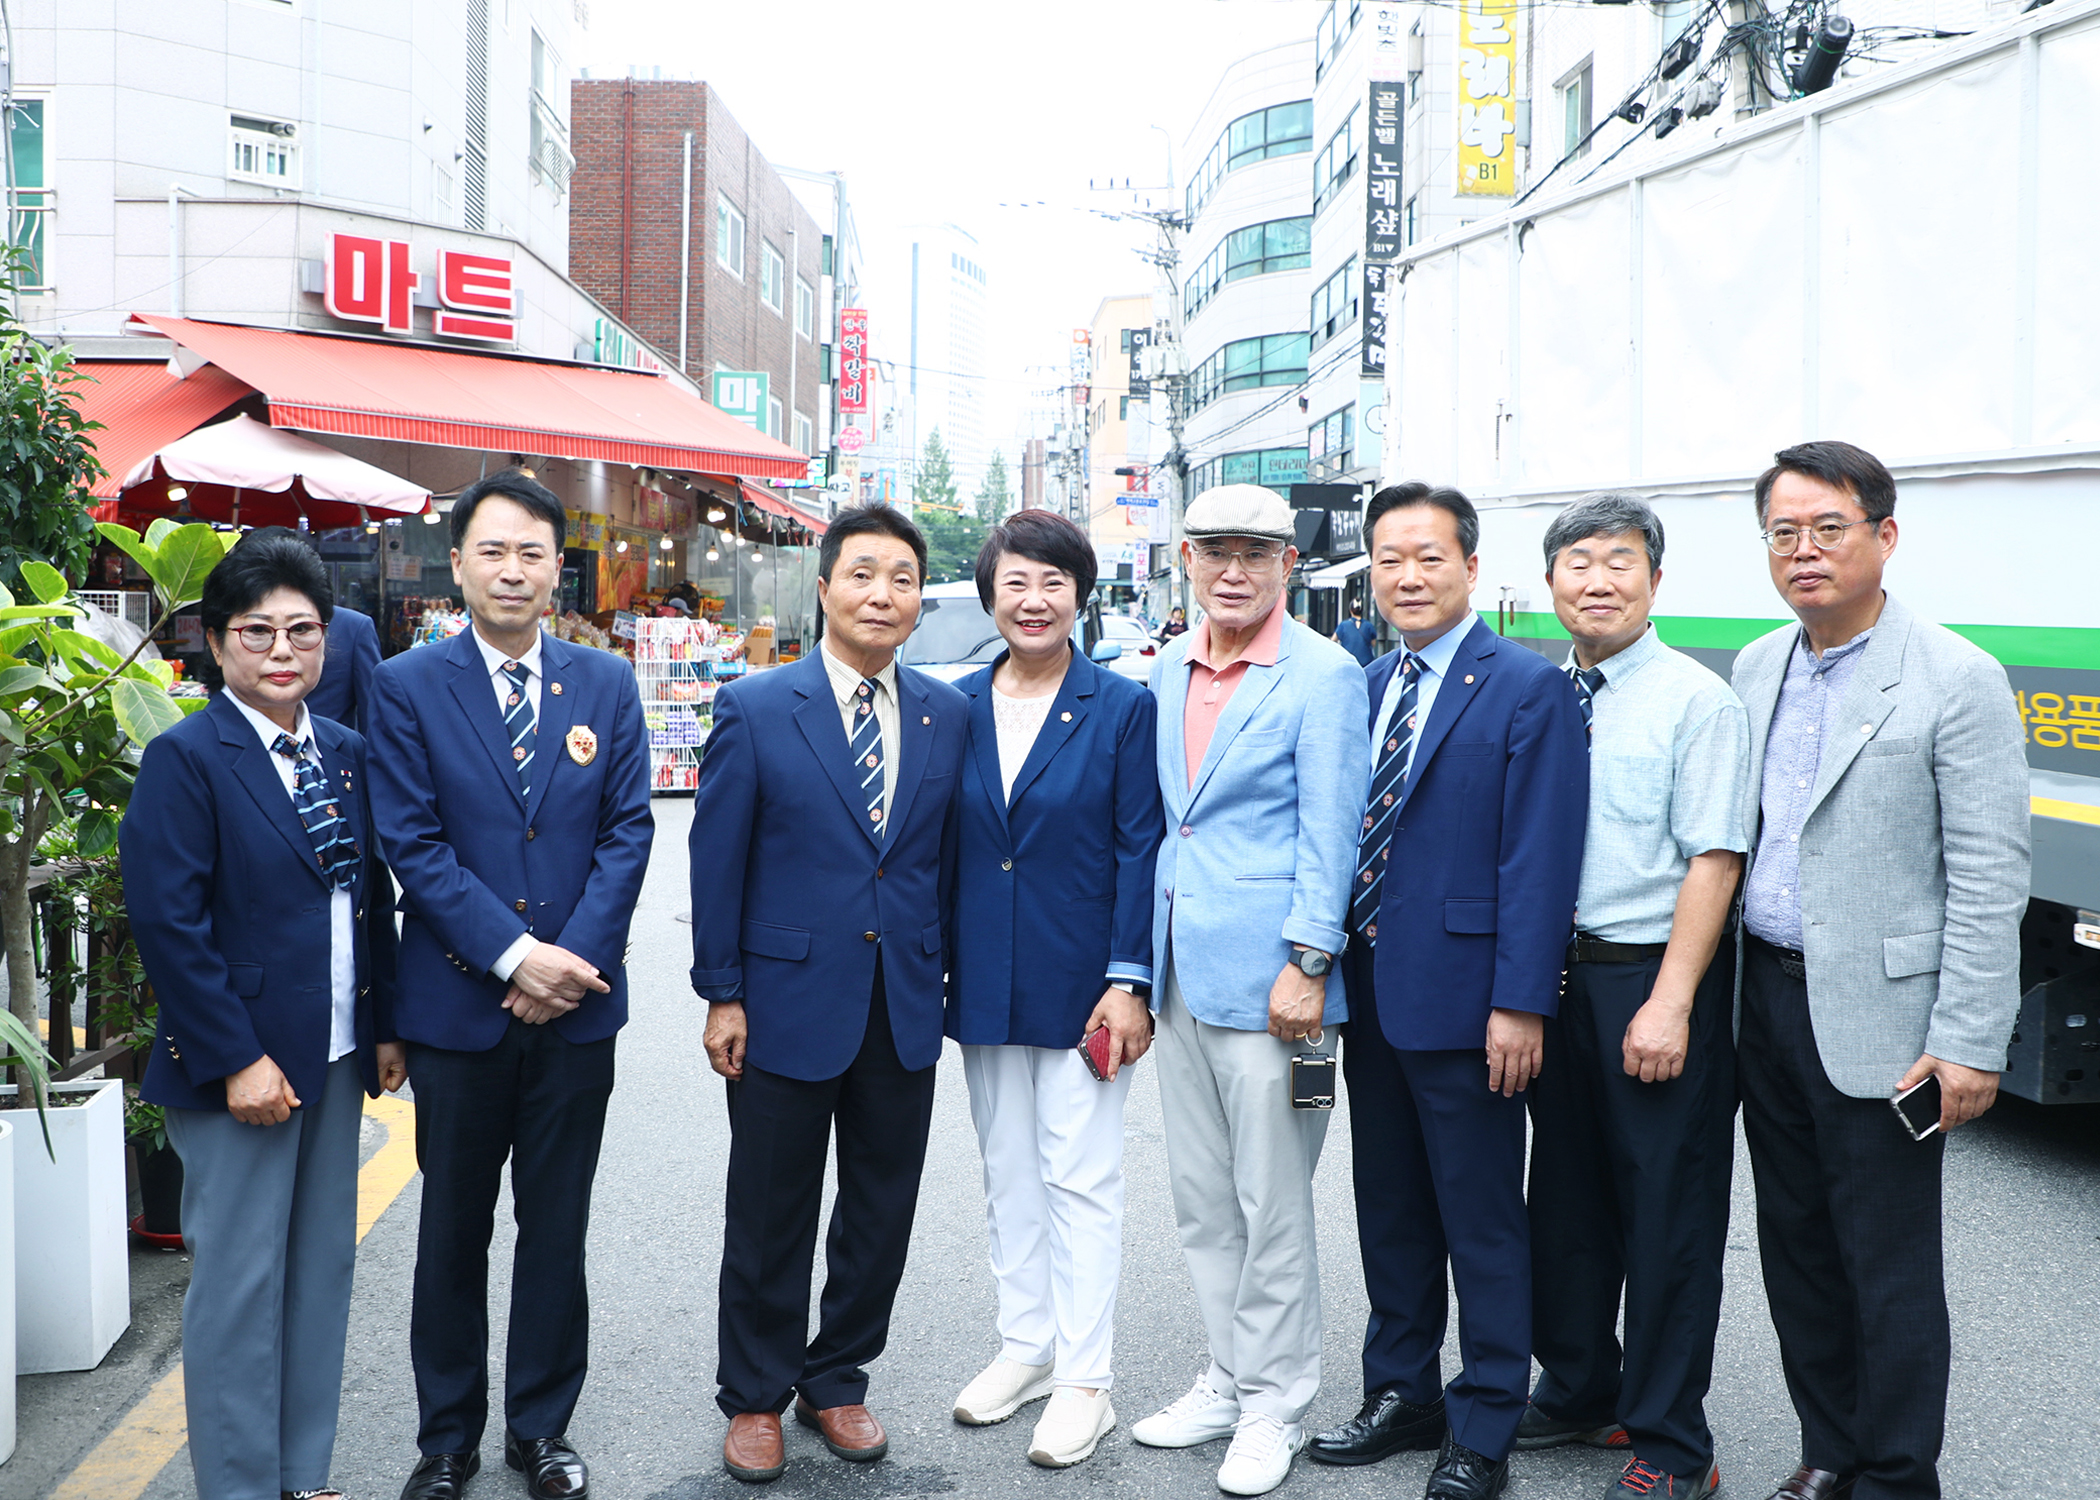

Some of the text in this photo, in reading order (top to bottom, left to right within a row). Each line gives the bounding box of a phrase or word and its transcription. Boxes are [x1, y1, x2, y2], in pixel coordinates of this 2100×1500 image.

[1374, 91, 1400, 145] 골든벨
[1480, 163, 1498, 181] B1
[1373, 243, 1385, 253] B1
[325, 232, 518, 342] 마트
